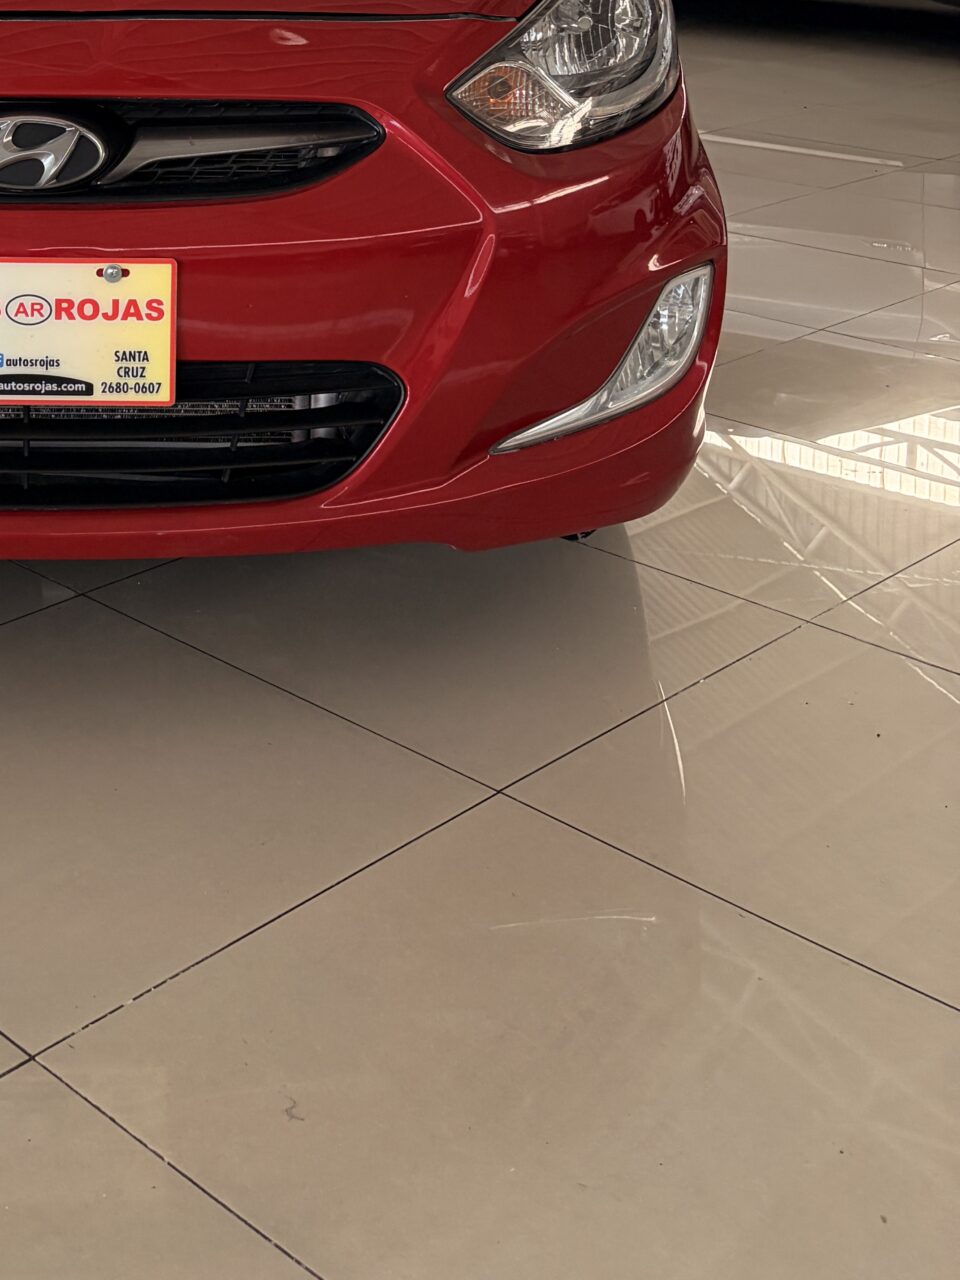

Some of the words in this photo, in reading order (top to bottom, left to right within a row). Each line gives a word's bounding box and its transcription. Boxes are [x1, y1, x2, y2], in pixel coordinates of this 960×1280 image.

[13, 303, 45, 318] AR
[54, 298, 165, 321] ROJAS
[5, 356, 60, 371] autosrojas
[114, 350, 149, 363] SANTA
[117, 366, 146, 378] CRUZ
[100, 381, 162, 395] 2680-0607
